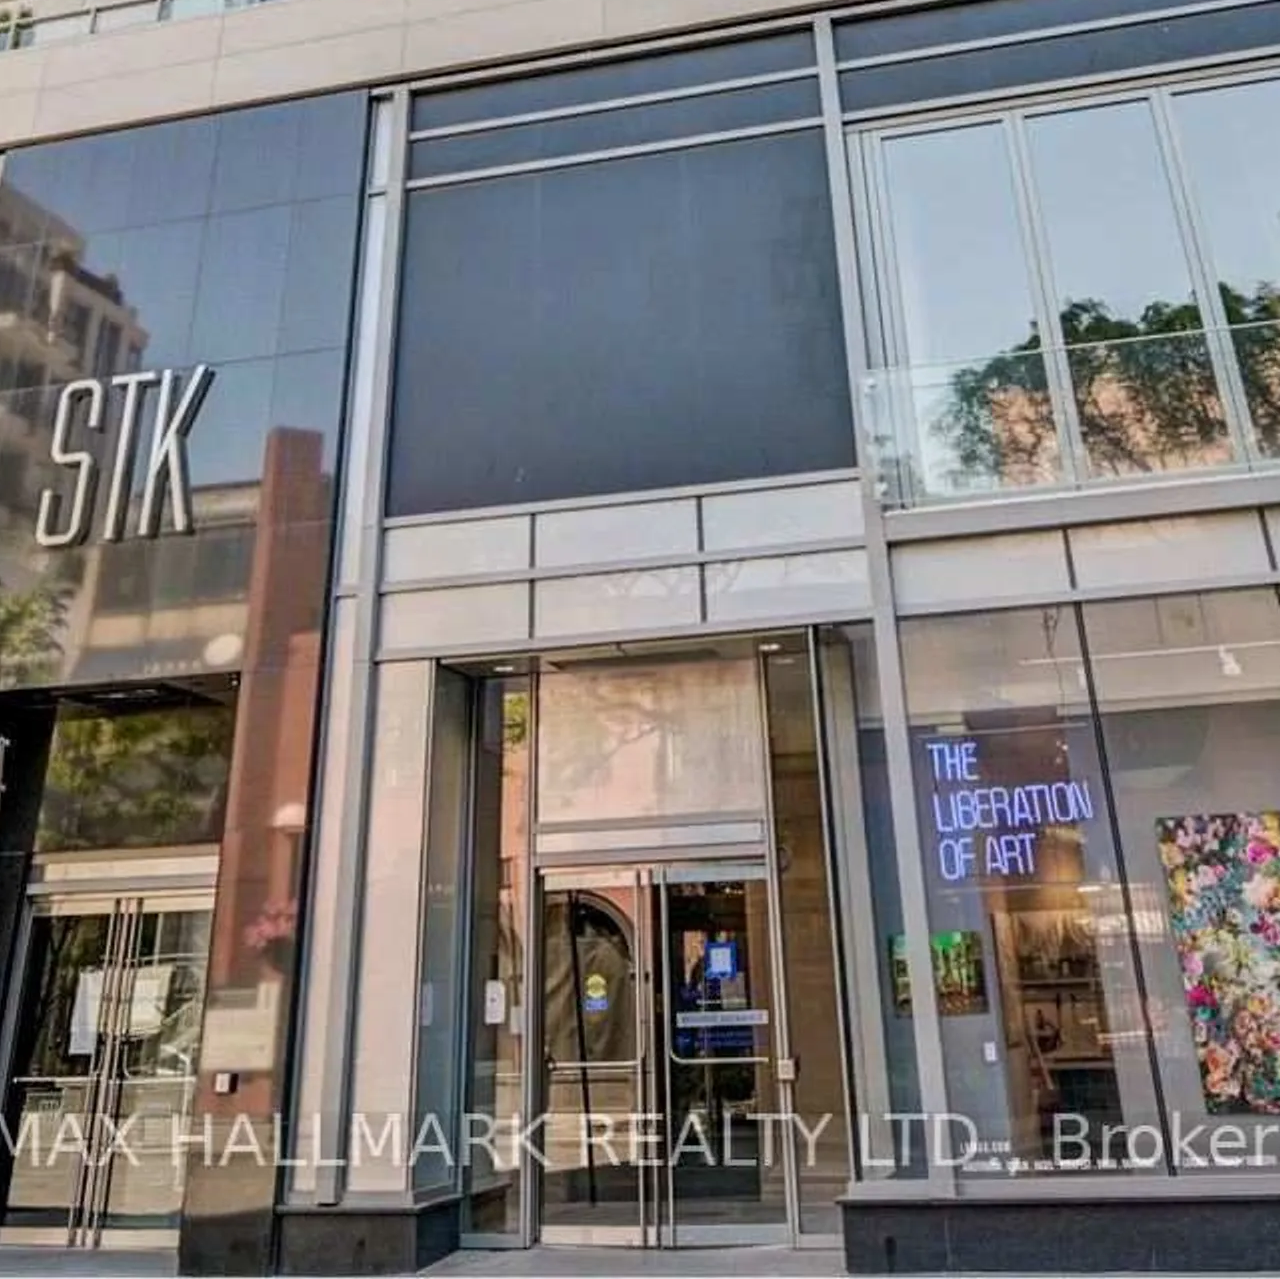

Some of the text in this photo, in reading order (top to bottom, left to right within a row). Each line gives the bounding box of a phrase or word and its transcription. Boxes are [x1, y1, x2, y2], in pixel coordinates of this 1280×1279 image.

[35, 363, 210, 546] STK
[925, 742, 980, 782] THE
[932, 779, 1094, 833] LIBERATION
[938, 832, 1036, 881] OF ART
